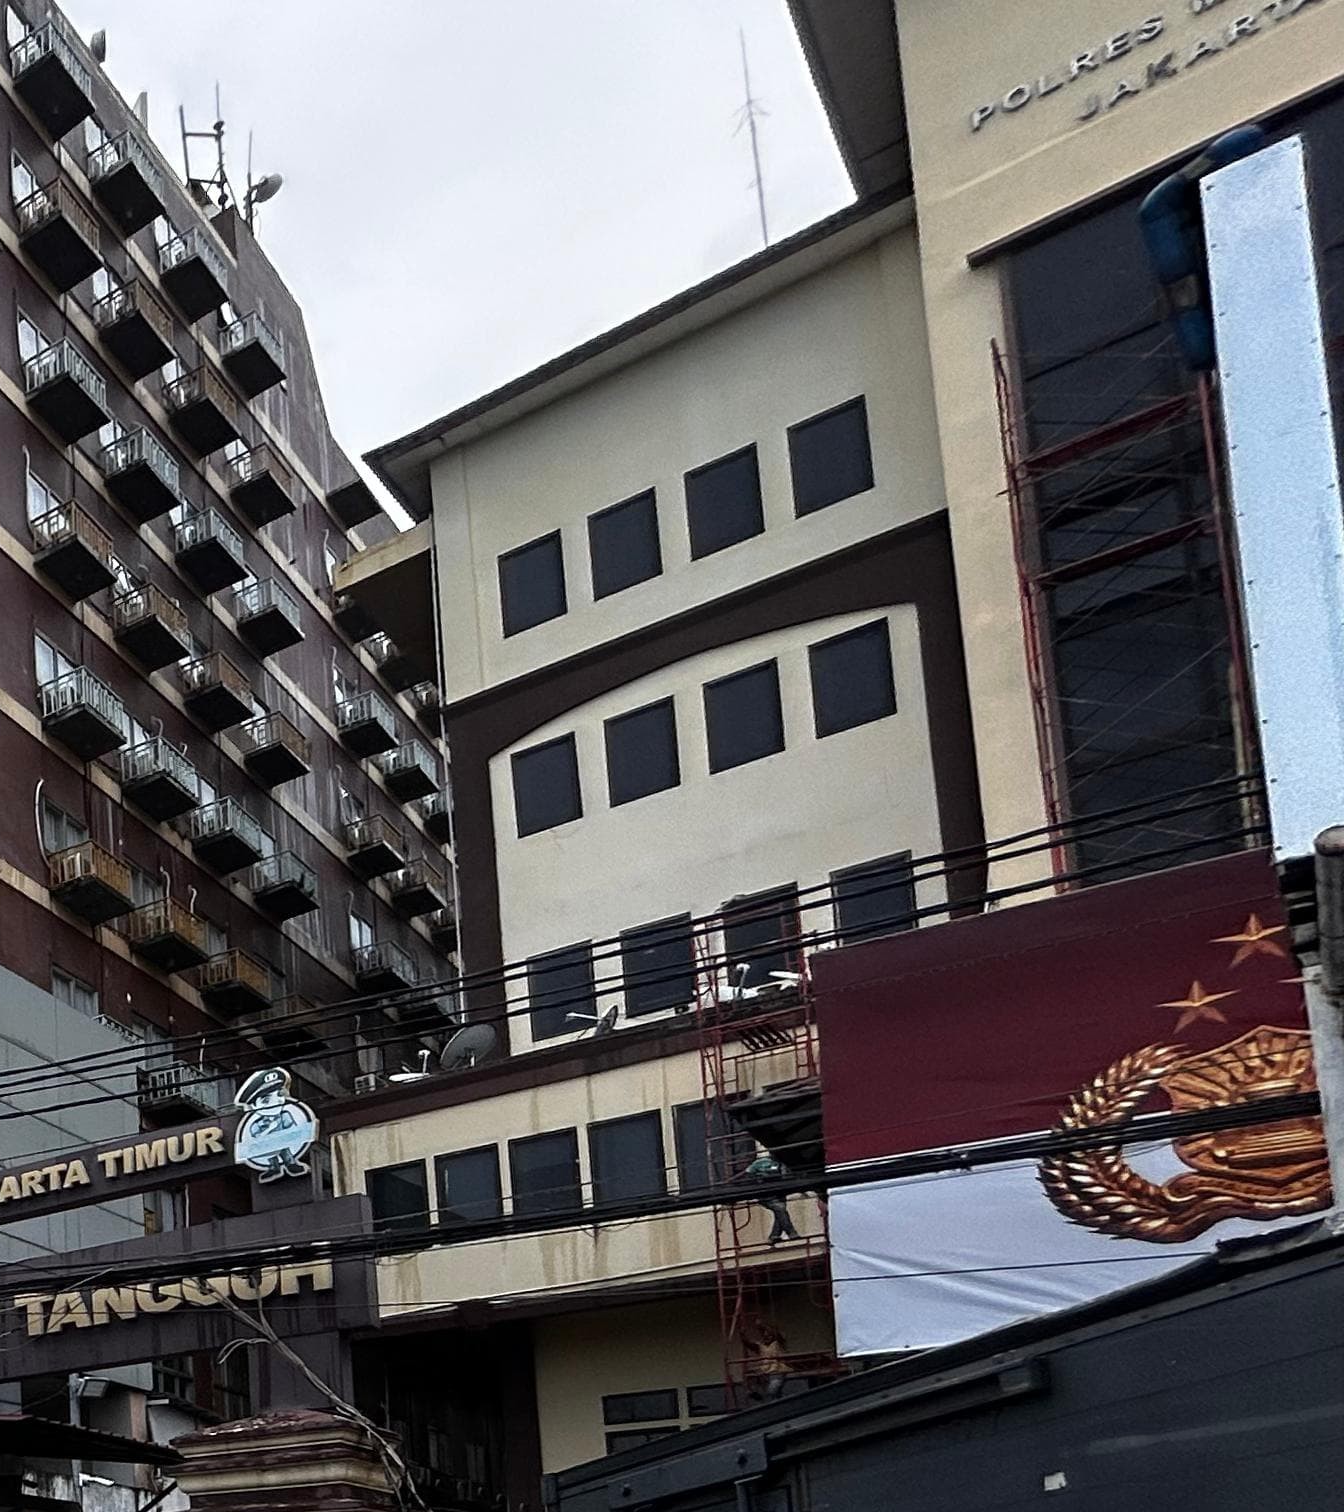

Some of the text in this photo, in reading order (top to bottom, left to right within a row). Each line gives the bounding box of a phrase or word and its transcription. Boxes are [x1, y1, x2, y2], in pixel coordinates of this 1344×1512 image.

[970, 14, 1165, 133] POLRES
[1075, 0, 1318, 122] JAKART
[97, 1126, 225, 1179] TIMUR
